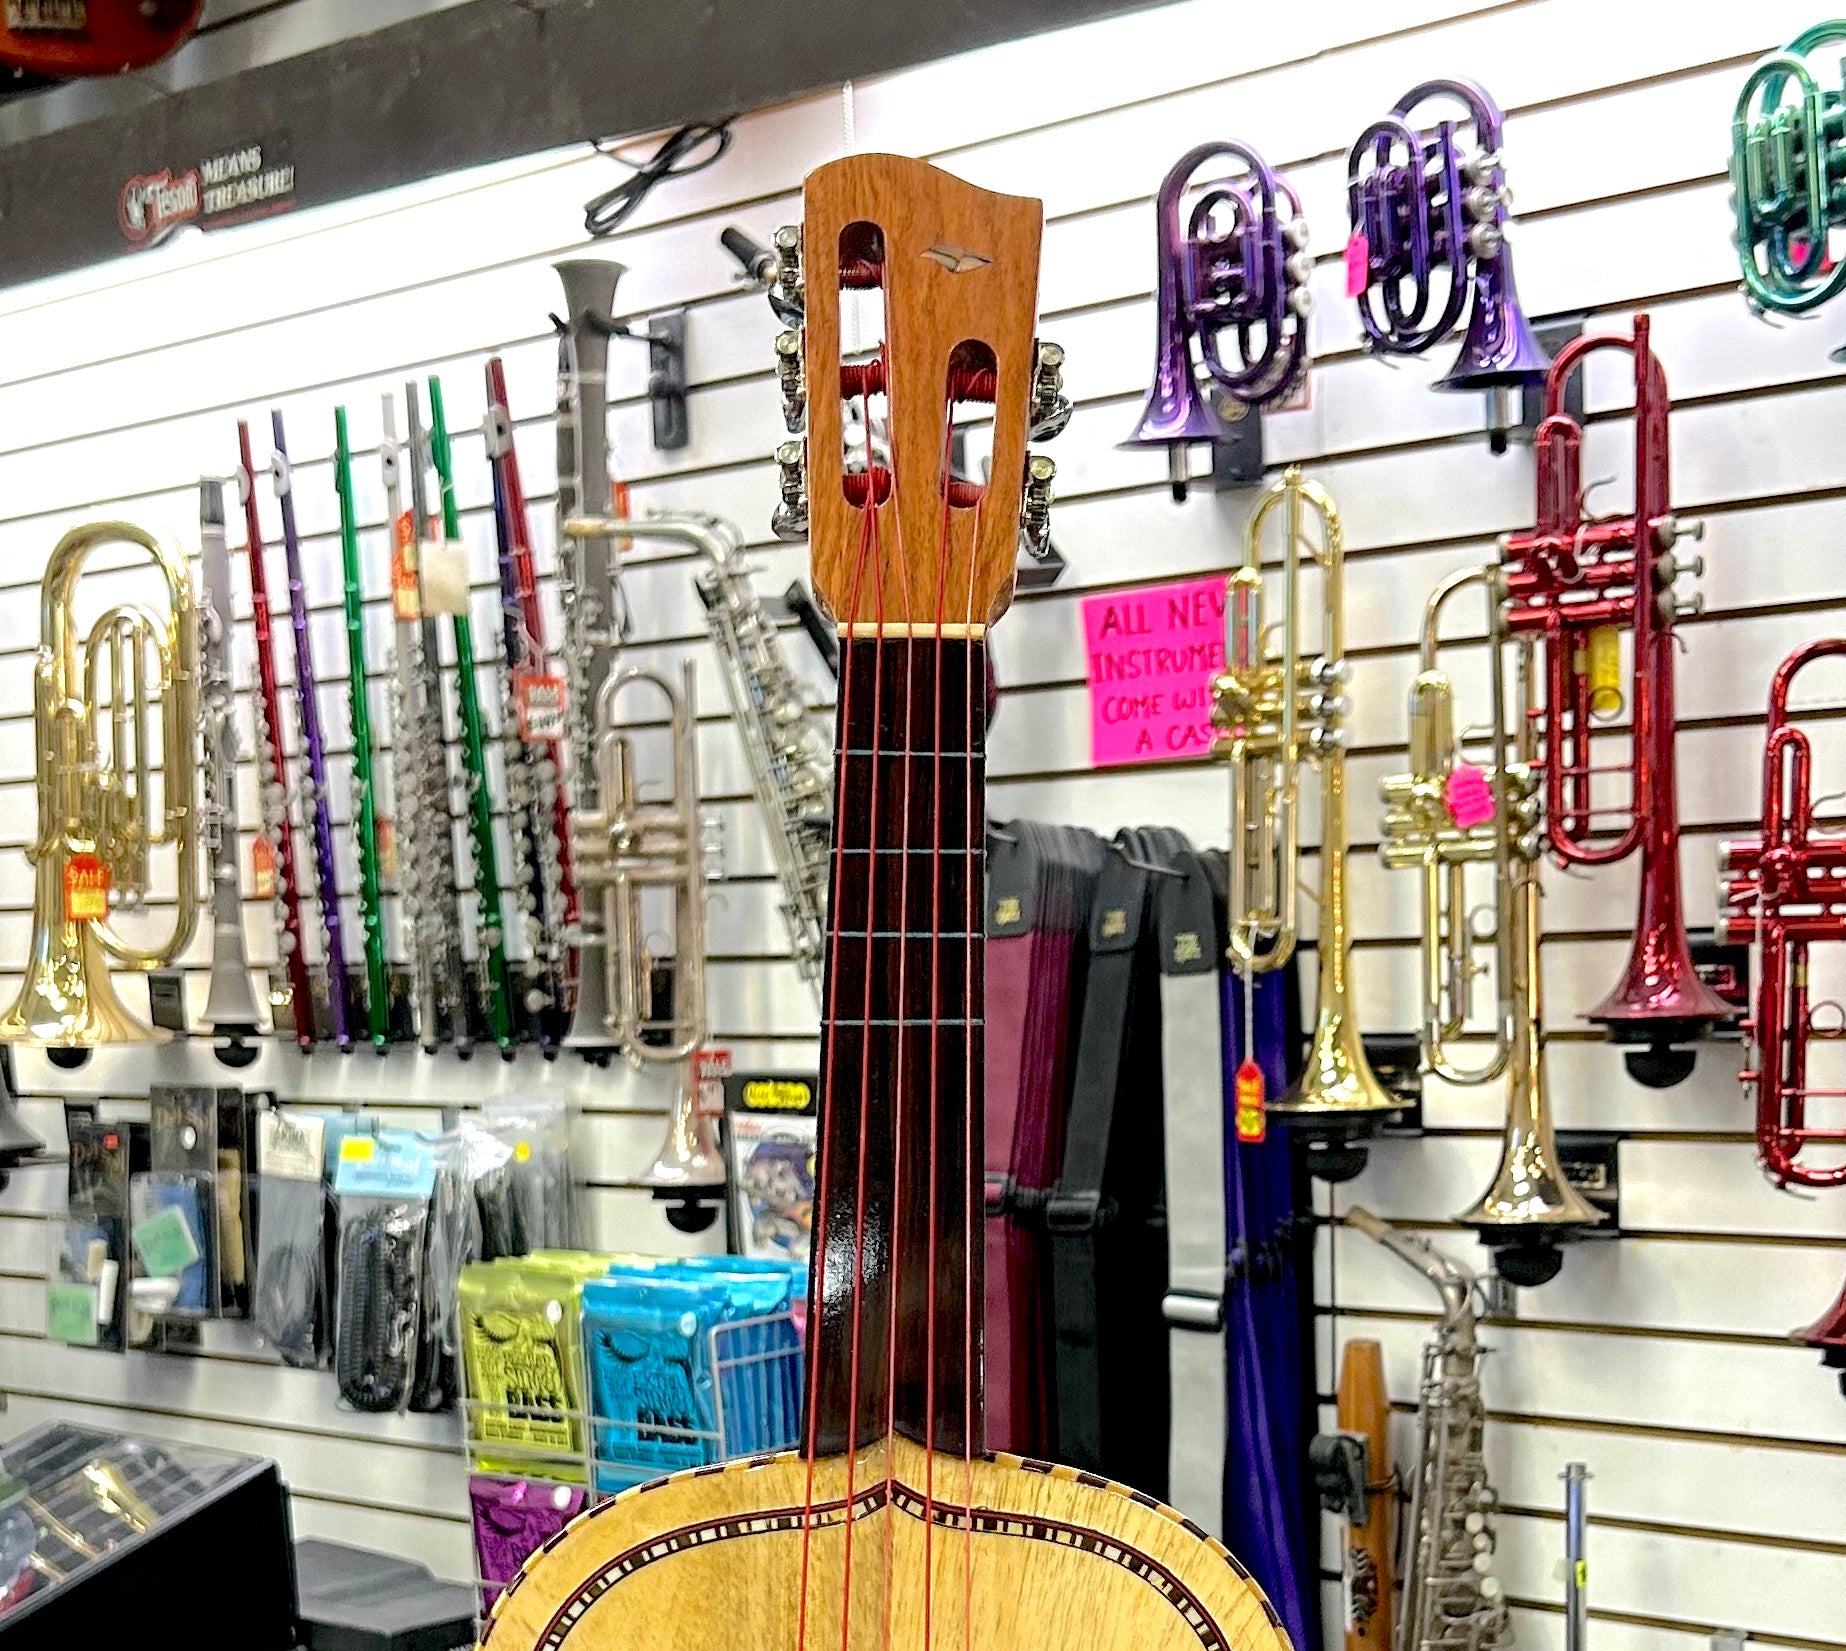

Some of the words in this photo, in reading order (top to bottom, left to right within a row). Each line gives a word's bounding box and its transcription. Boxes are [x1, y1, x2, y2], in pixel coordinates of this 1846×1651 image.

[201, 145, 262, 184] MEANS
[1100, 605, 1153, 640] ALL
[1092, 642, 1223, 683] INSTRUME
[1101, 694, 1165, 725] COME
[1173, 686, 1213, 711] WI
[1136, 728, 1154, 754] A
[1165, 722, 1213, 750] CAS
